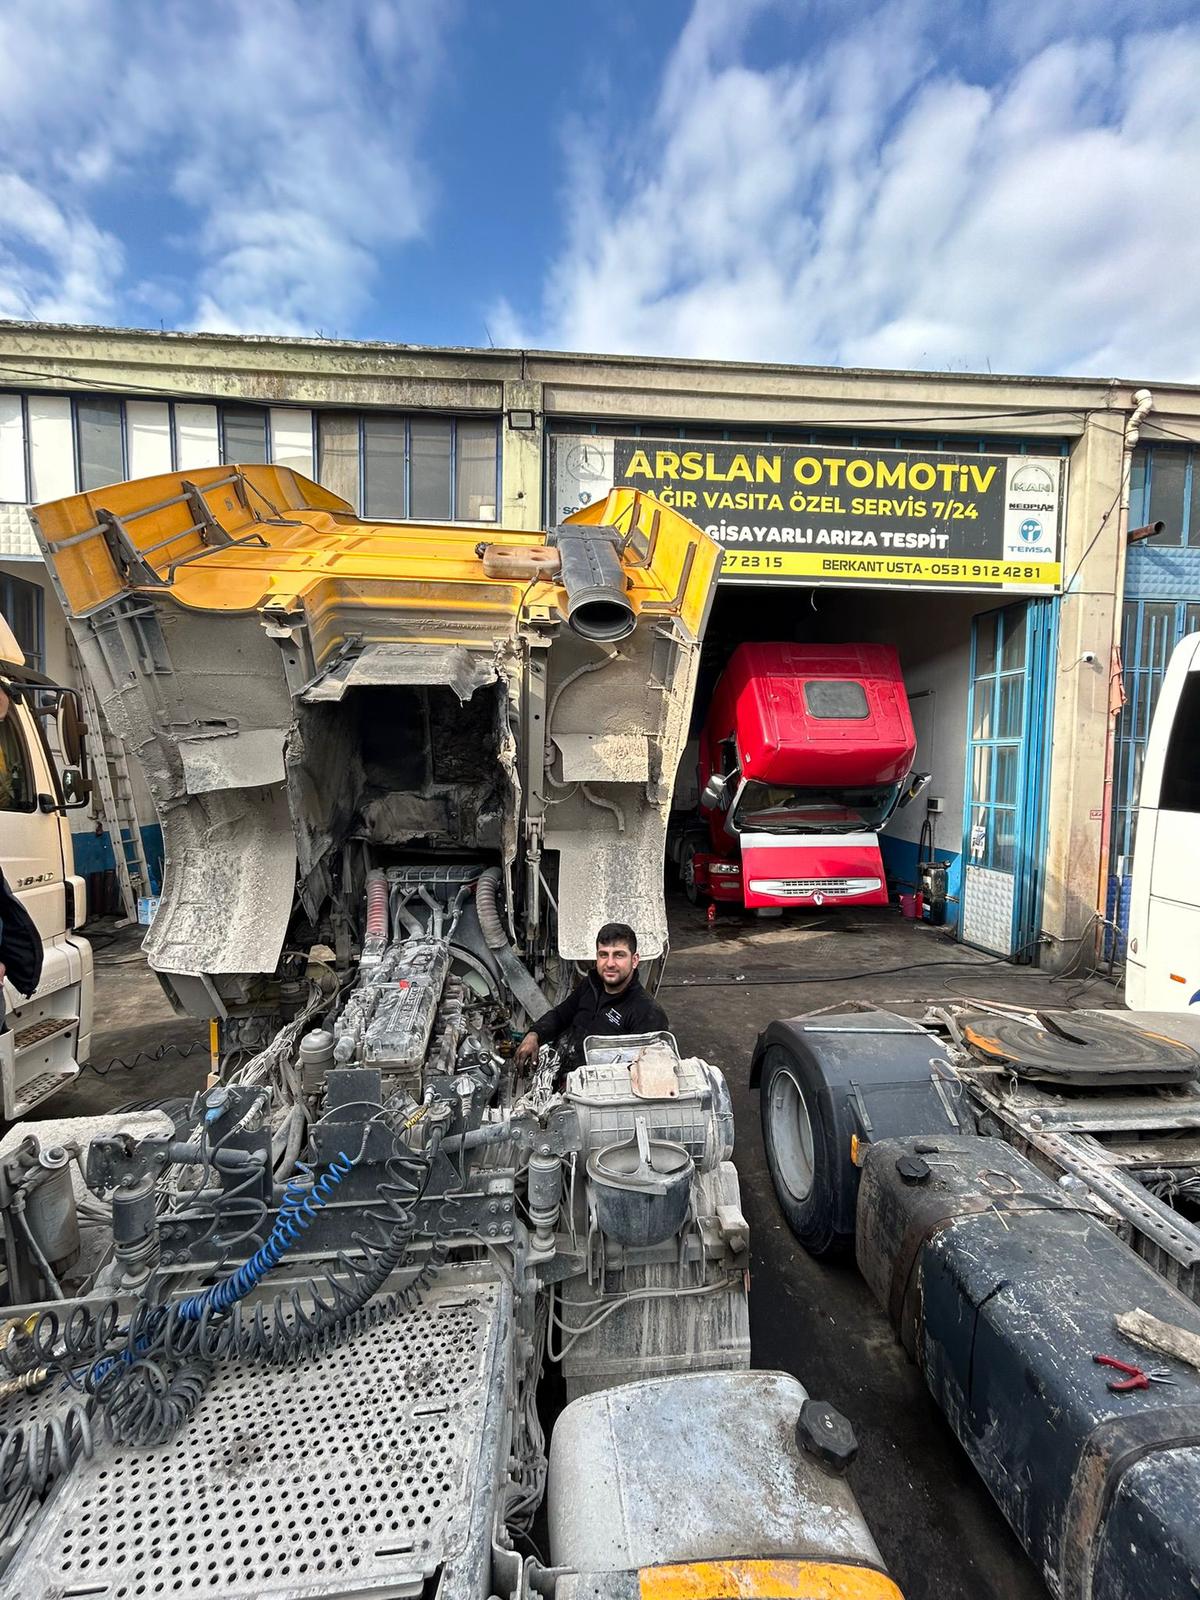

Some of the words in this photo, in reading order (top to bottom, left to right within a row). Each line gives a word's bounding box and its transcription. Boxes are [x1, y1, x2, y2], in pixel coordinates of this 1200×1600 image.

[624, 449, 781, 483] ARSLAN
[1013, 482, 1051, 492] MAN
[703, 491, 784, 510] VASITA
[789, 490, 846, 514] ÖZEL
[851, 495, 927, 518] SERVİS
[932, 500, 979, 520] 7/24
[704, 519, 812, 545] GİSAYARLI
[816, 528, 878, 547] ARIZA
[880, 527, 950, 550] TESPİT
[1008, 545, 1053, 554] TEMSA
[822, 559, 884, 573] BERKANT
[886, 561, 922, 574] USTA
